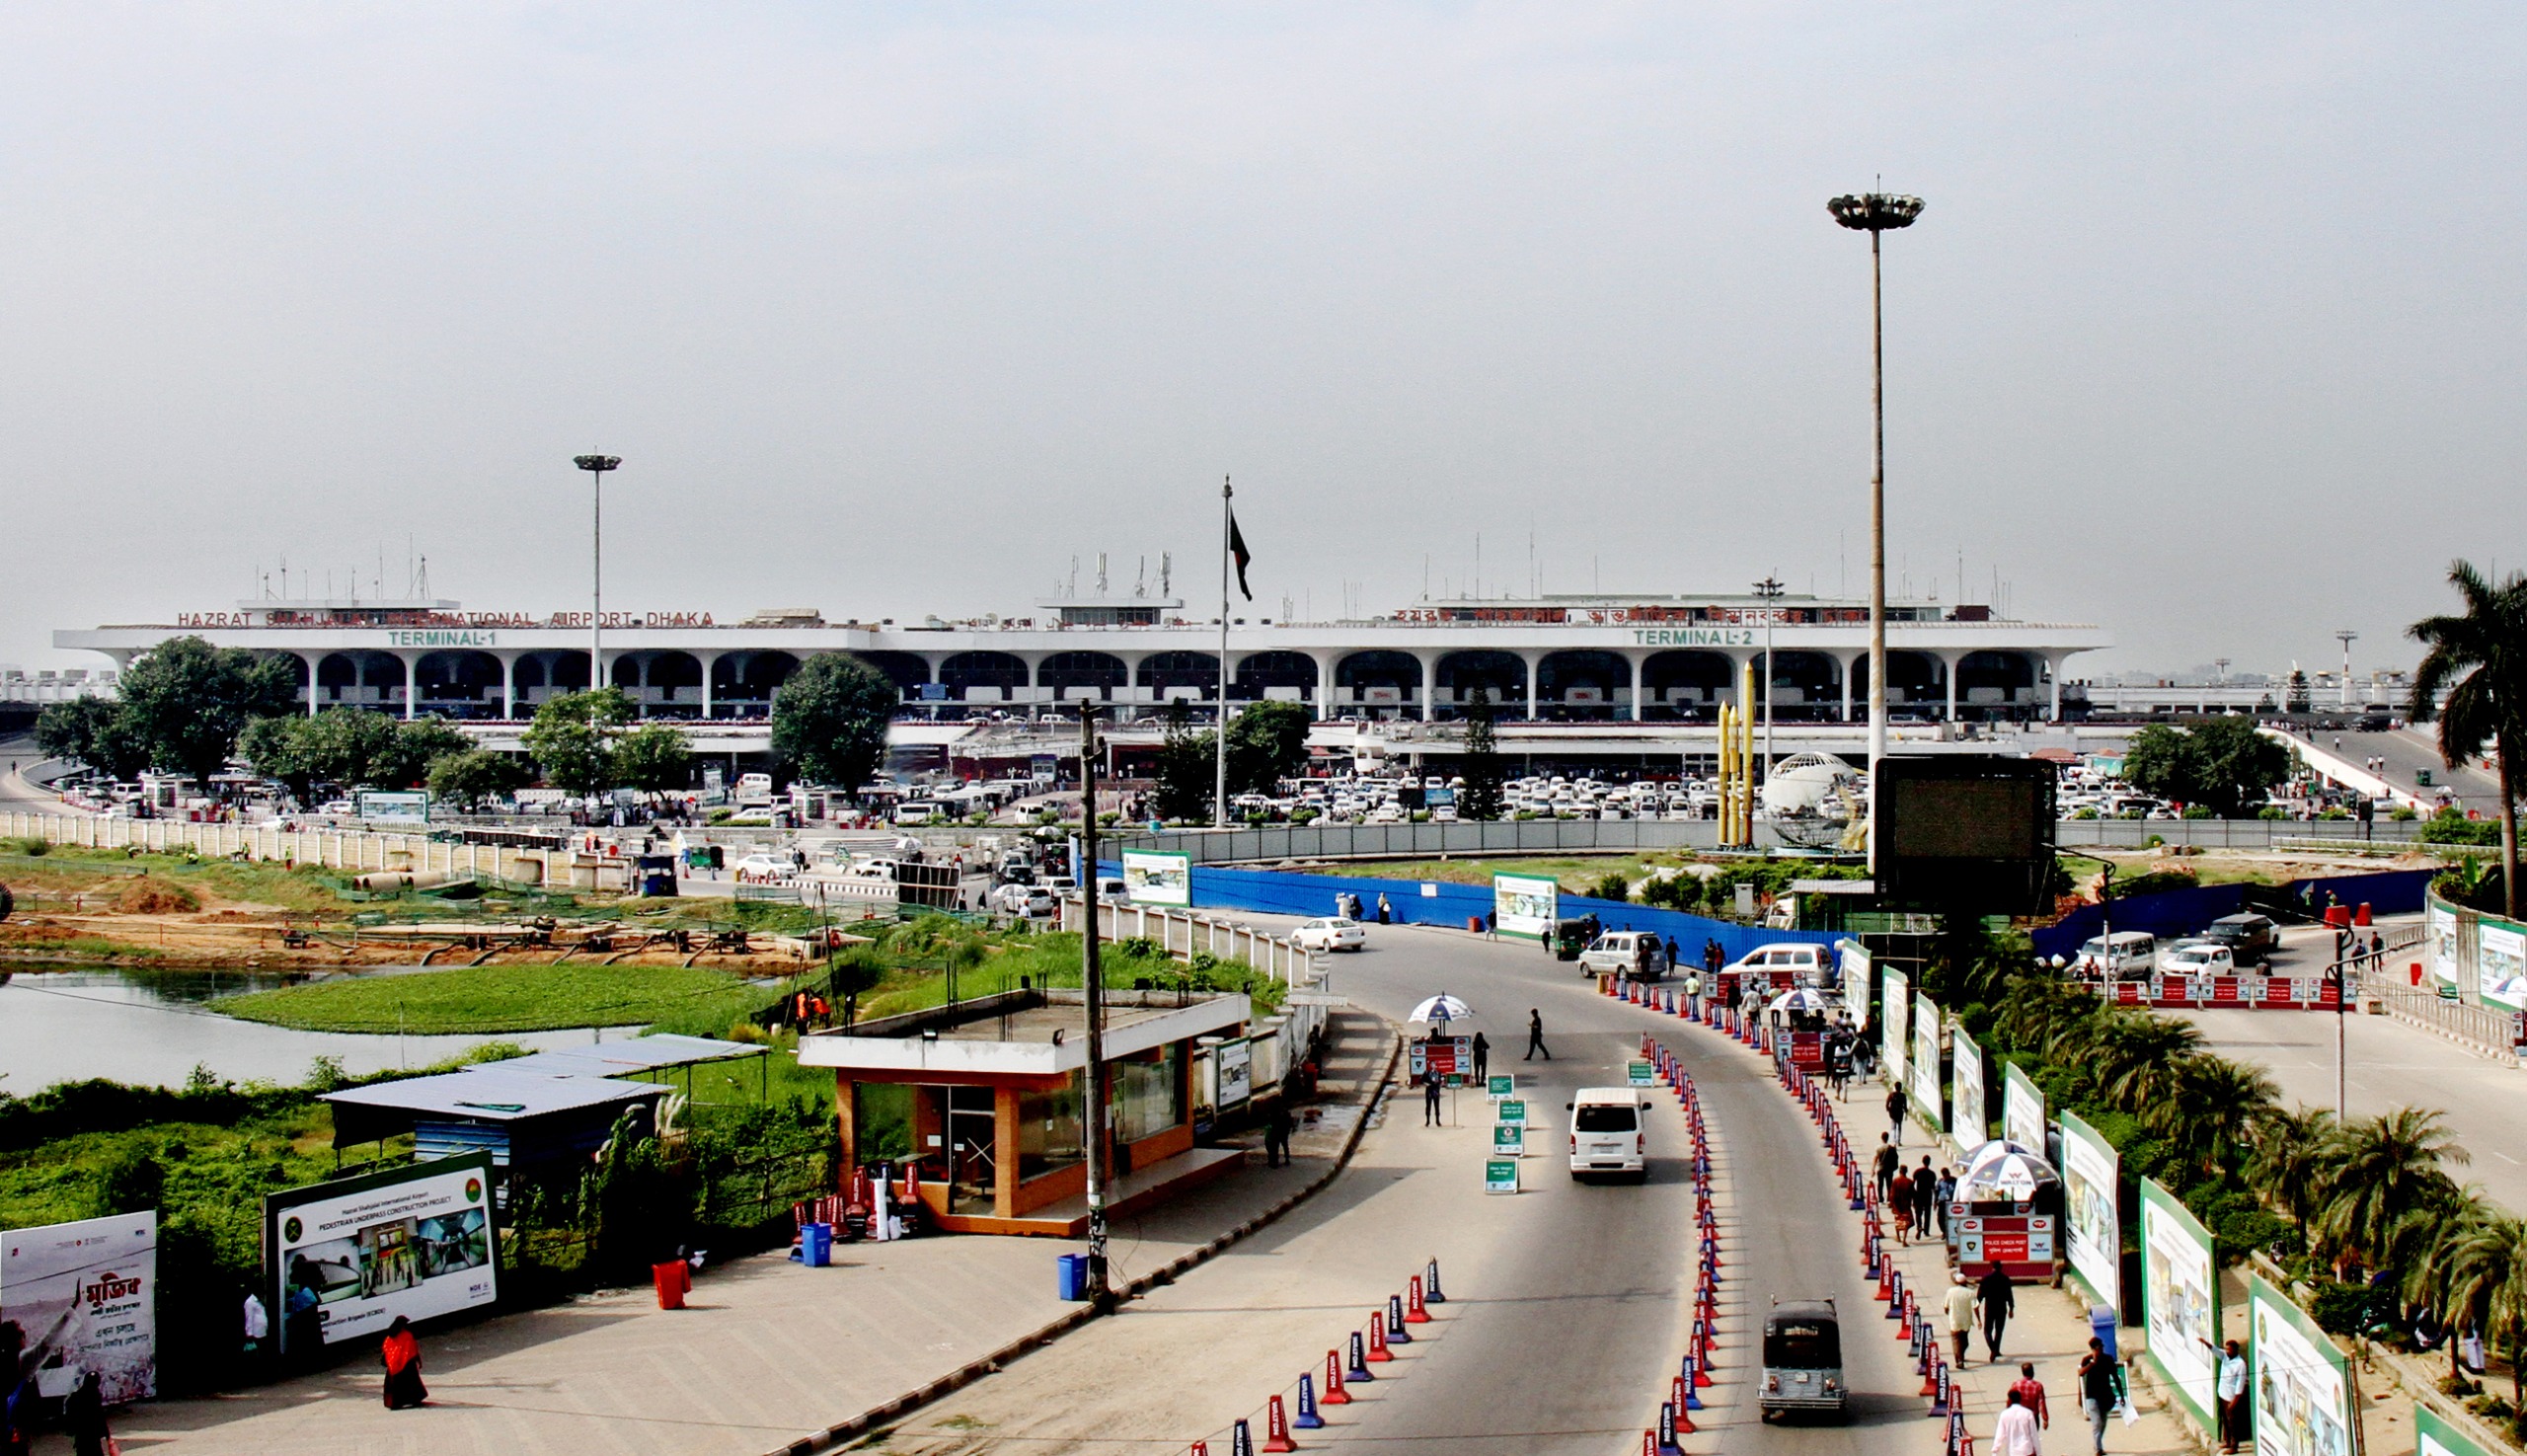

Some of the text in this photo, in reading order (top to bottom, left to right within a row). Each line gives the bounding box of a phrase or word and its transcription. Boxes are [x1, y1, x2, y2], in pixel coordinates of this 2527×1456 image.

[178, 612, 253, 627] HAZRAT
[386, 611, 540, 627] INTERNATIONAL
[550, 611, 633, 627] AIRPORT
[647, 611, 714, 627] DHAKA
[388, 631, 497, 646] TERMINAL-1
[381, 1195, 411, 1206] International
[412, 1191, 428, 1201] Airport
[319, 1195, 452, 1231] PEDESTRIAN UNDERPASS CONSTRUCTION PROJECT
[86, 1271, 142, 1309] মুজিব
[1271, 1401, 1280, 1435] WALTON
